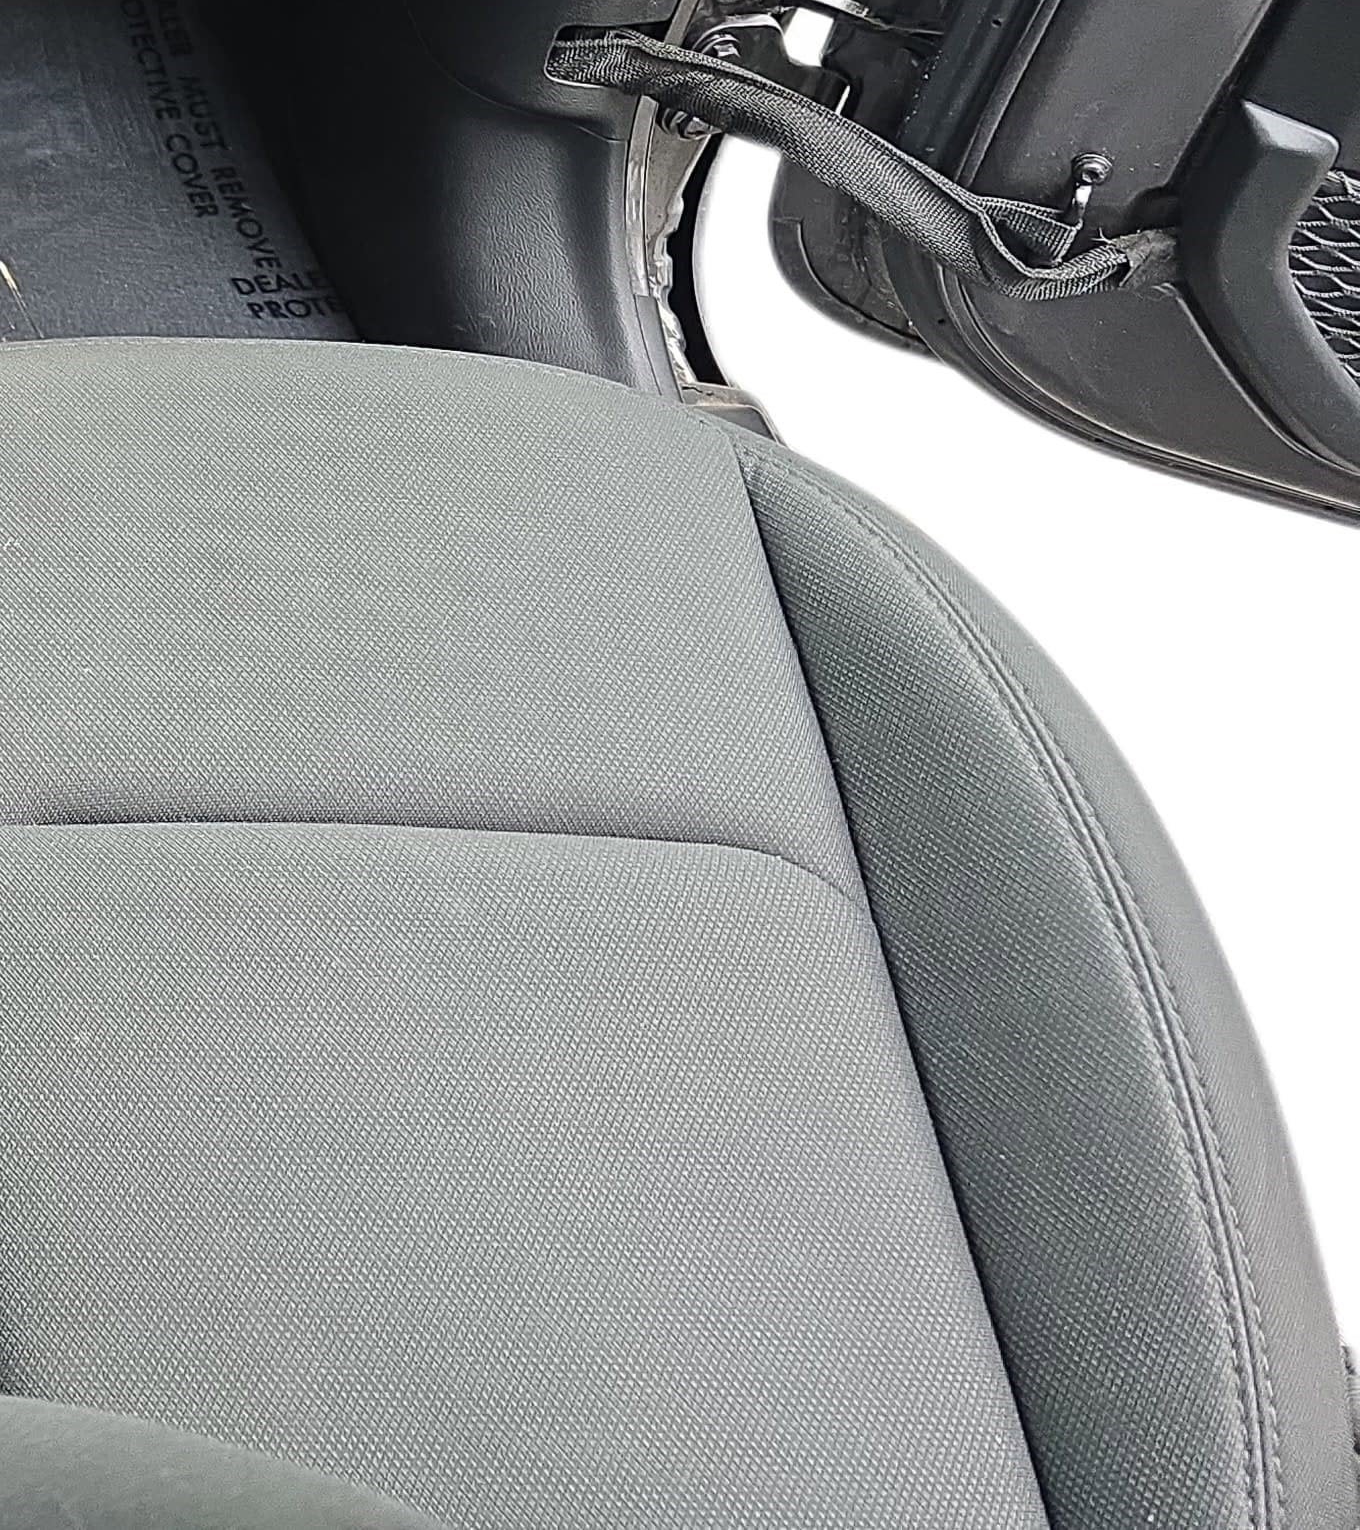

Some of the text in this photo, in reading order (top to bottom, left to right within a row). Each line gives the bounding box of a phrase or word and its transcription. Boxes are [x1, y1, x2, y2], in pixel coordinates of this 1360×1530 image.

[164, 132, 220, 219] COVER
[177, 75, 283, 270] MUST REMOVE
